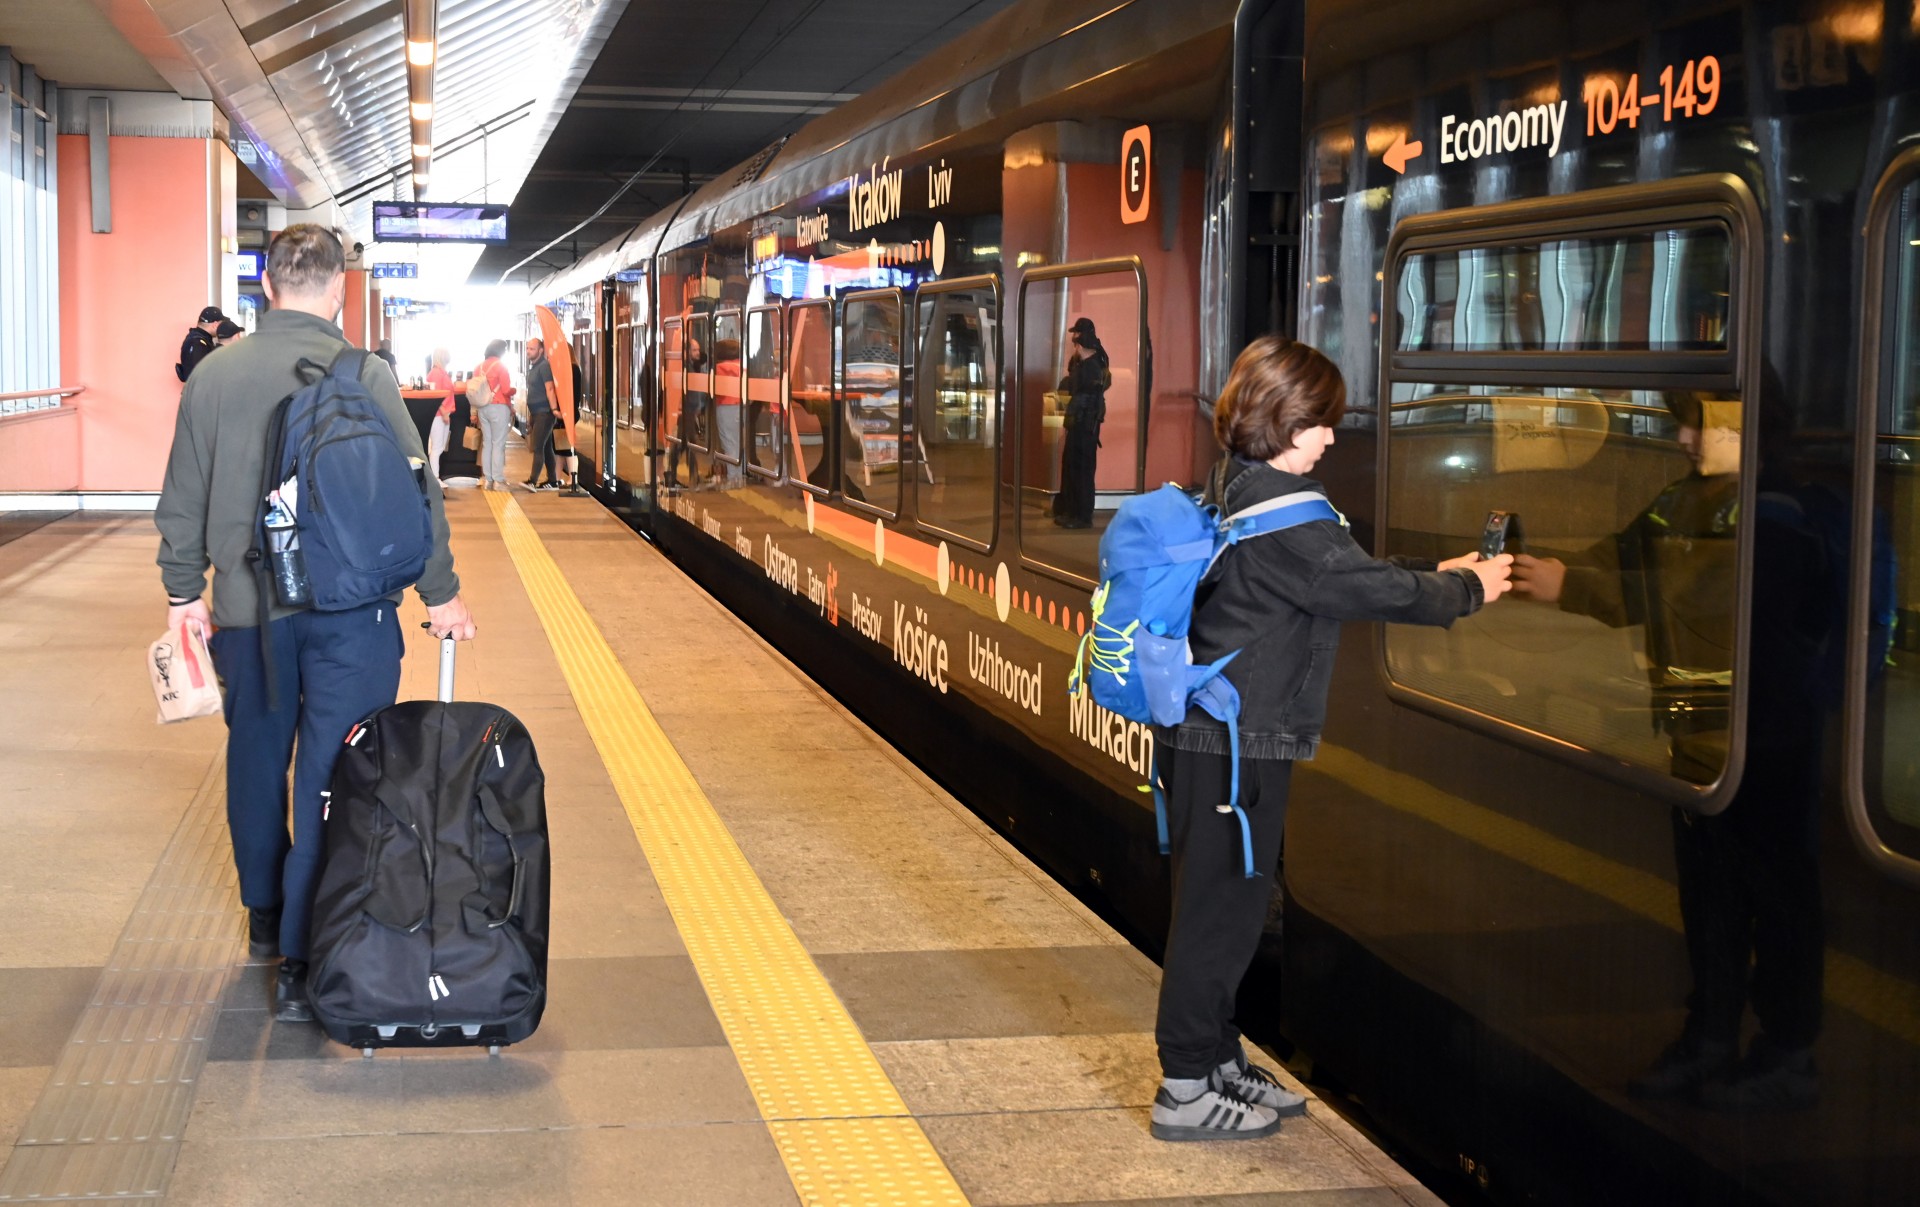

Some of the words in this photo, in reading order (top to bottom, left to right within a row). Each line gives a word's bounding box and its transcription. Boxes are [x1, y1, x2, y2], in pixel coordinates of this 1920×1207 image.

[1440, 99, 1567, 164] Economy
[849, 155, 903, 233] Kraków
[928, 158, 953, 209] Lviv
[1131, 156, 1140, 192] E
[796, 206, 829, 249] Katowice
[764, 533, 798, 596] Ostrava
[807, 566, 826, 617] Tatry
[852, 591, 882, 644] Prešov
[893, 600, 949, 694] Košice
[969, 630, 1042, 716] Uzhhorod
